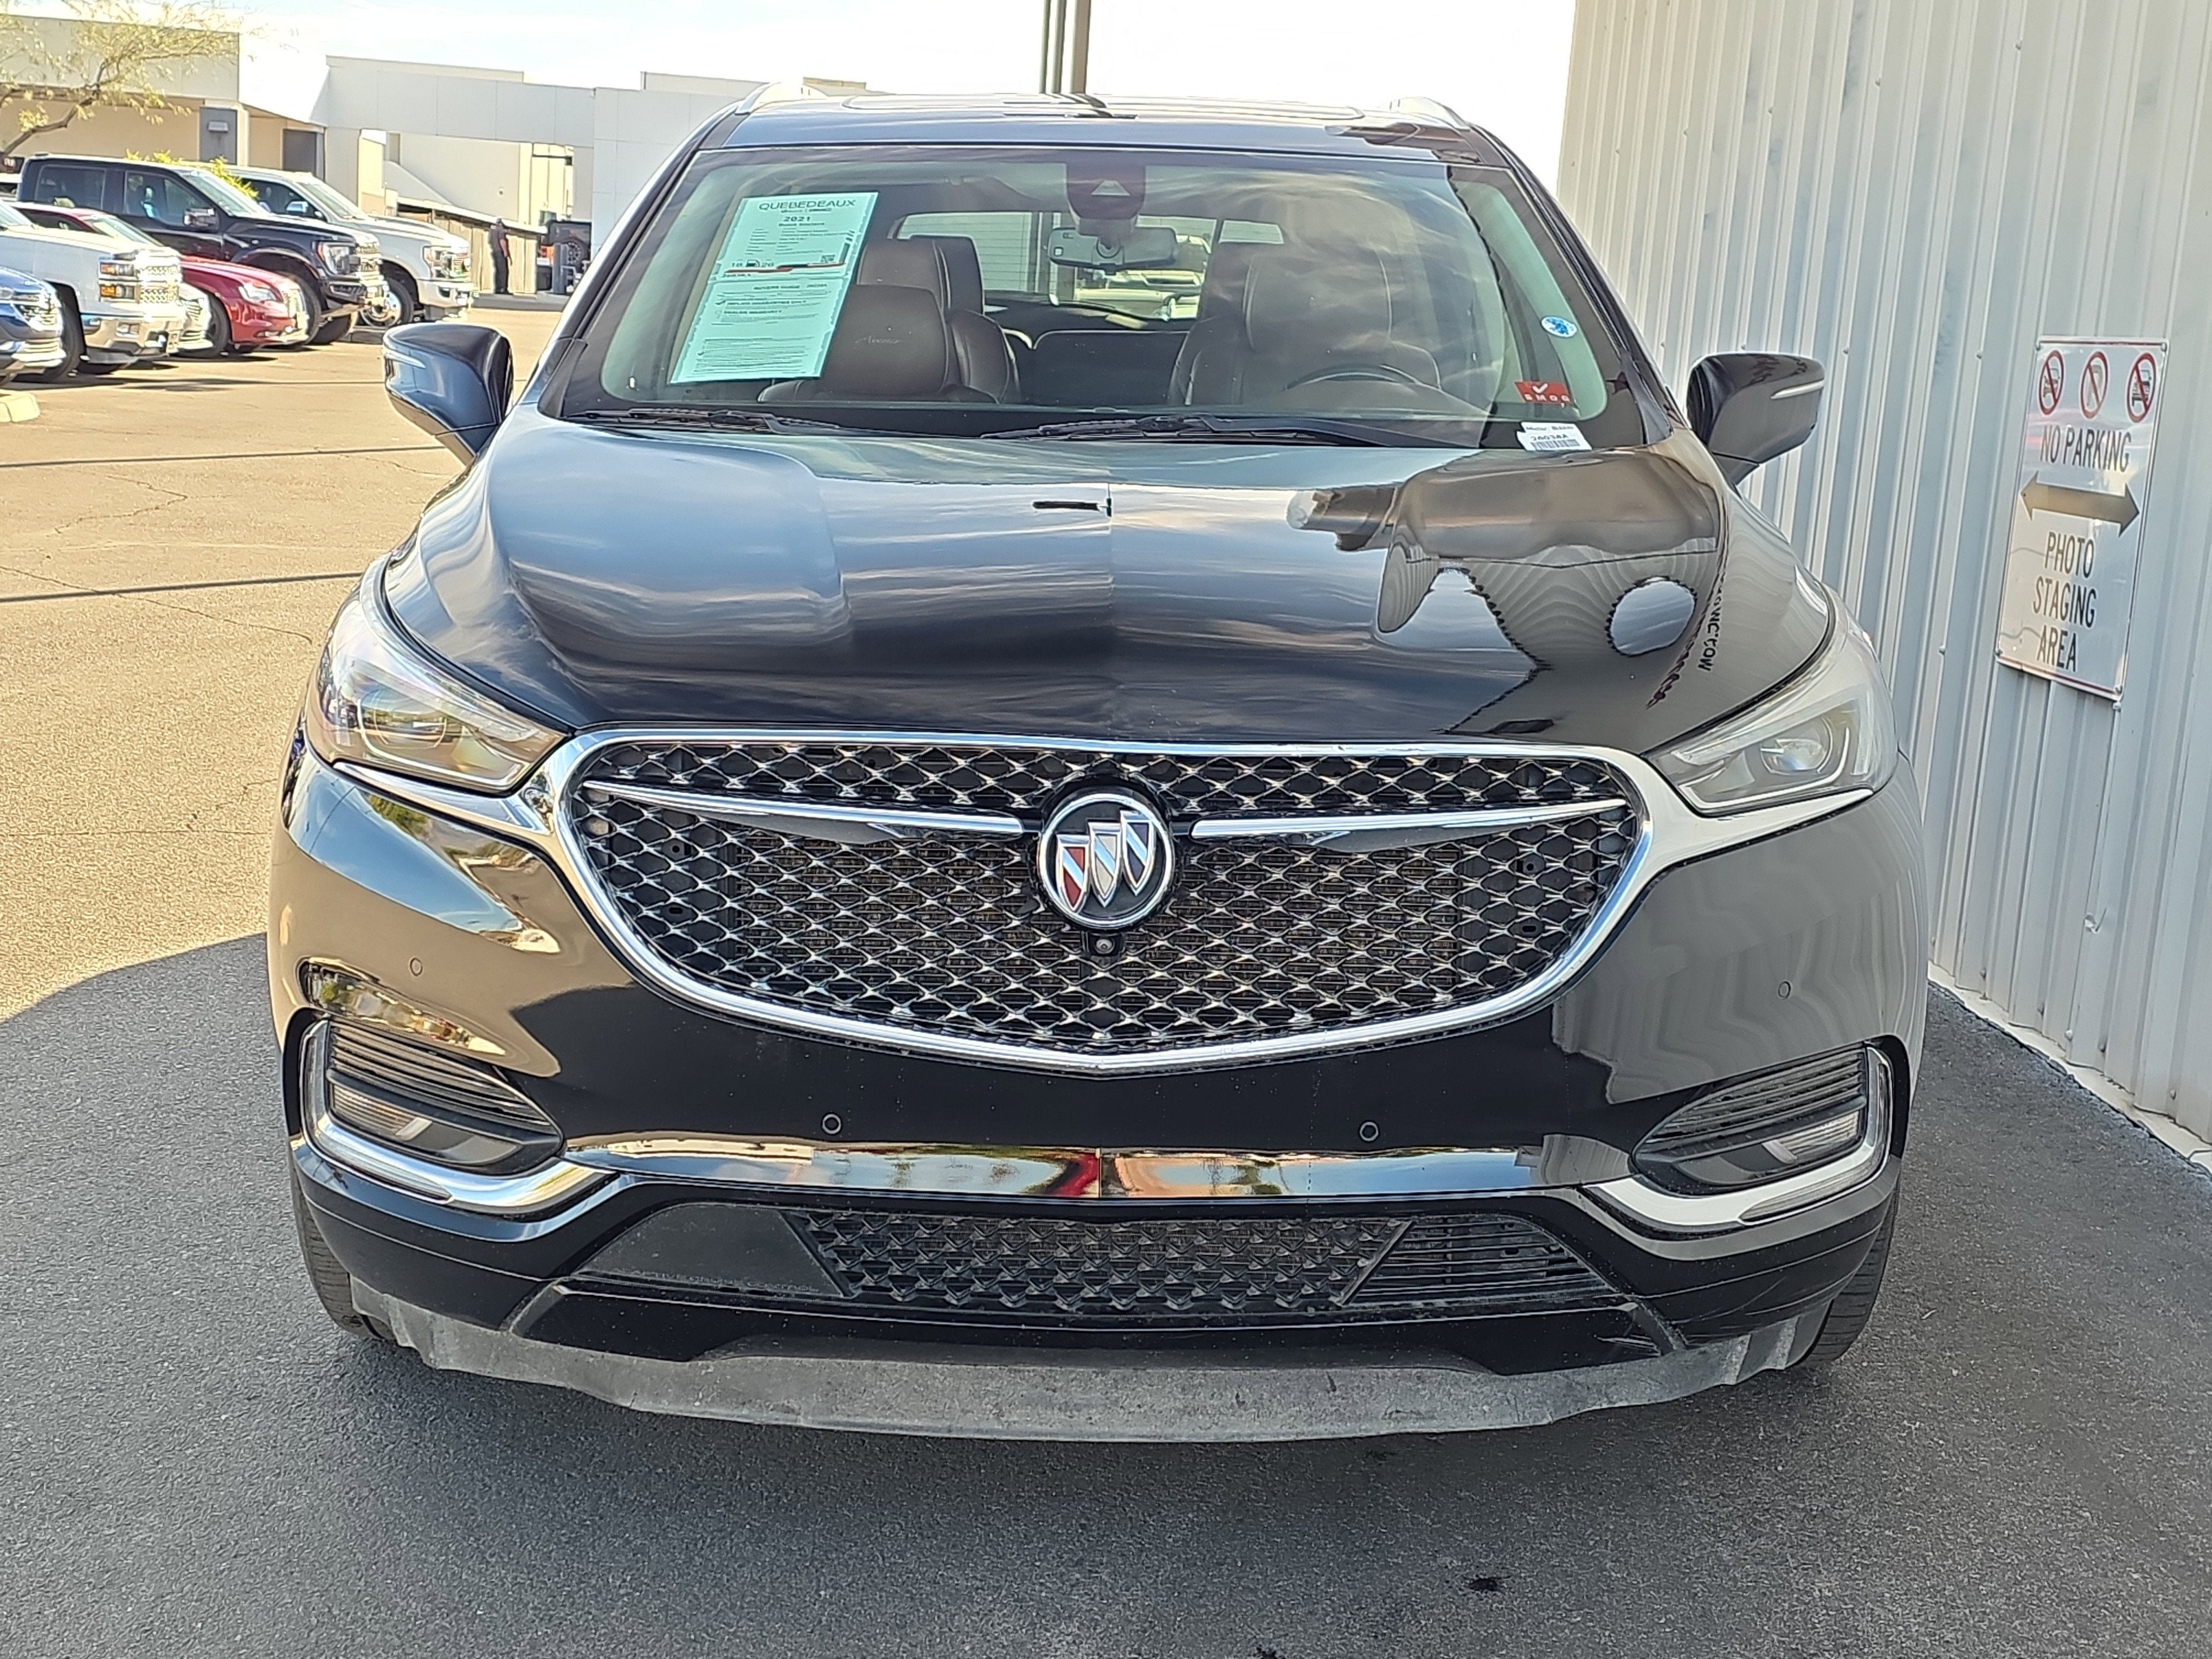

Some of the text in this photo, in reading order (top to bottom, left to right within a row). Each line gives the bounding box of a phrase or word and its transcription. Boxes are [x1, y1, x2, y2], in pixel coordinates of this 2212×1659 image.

[759, 200, 856, 210] QUEBEDEAUX
[2040, 425, 2131, 472] NO PARKING
[2044, 531, 2094, 578] PHOTO
[2033, 577, 2097, 628] STAGING
[2037, 625, 2078, 672] AREA
